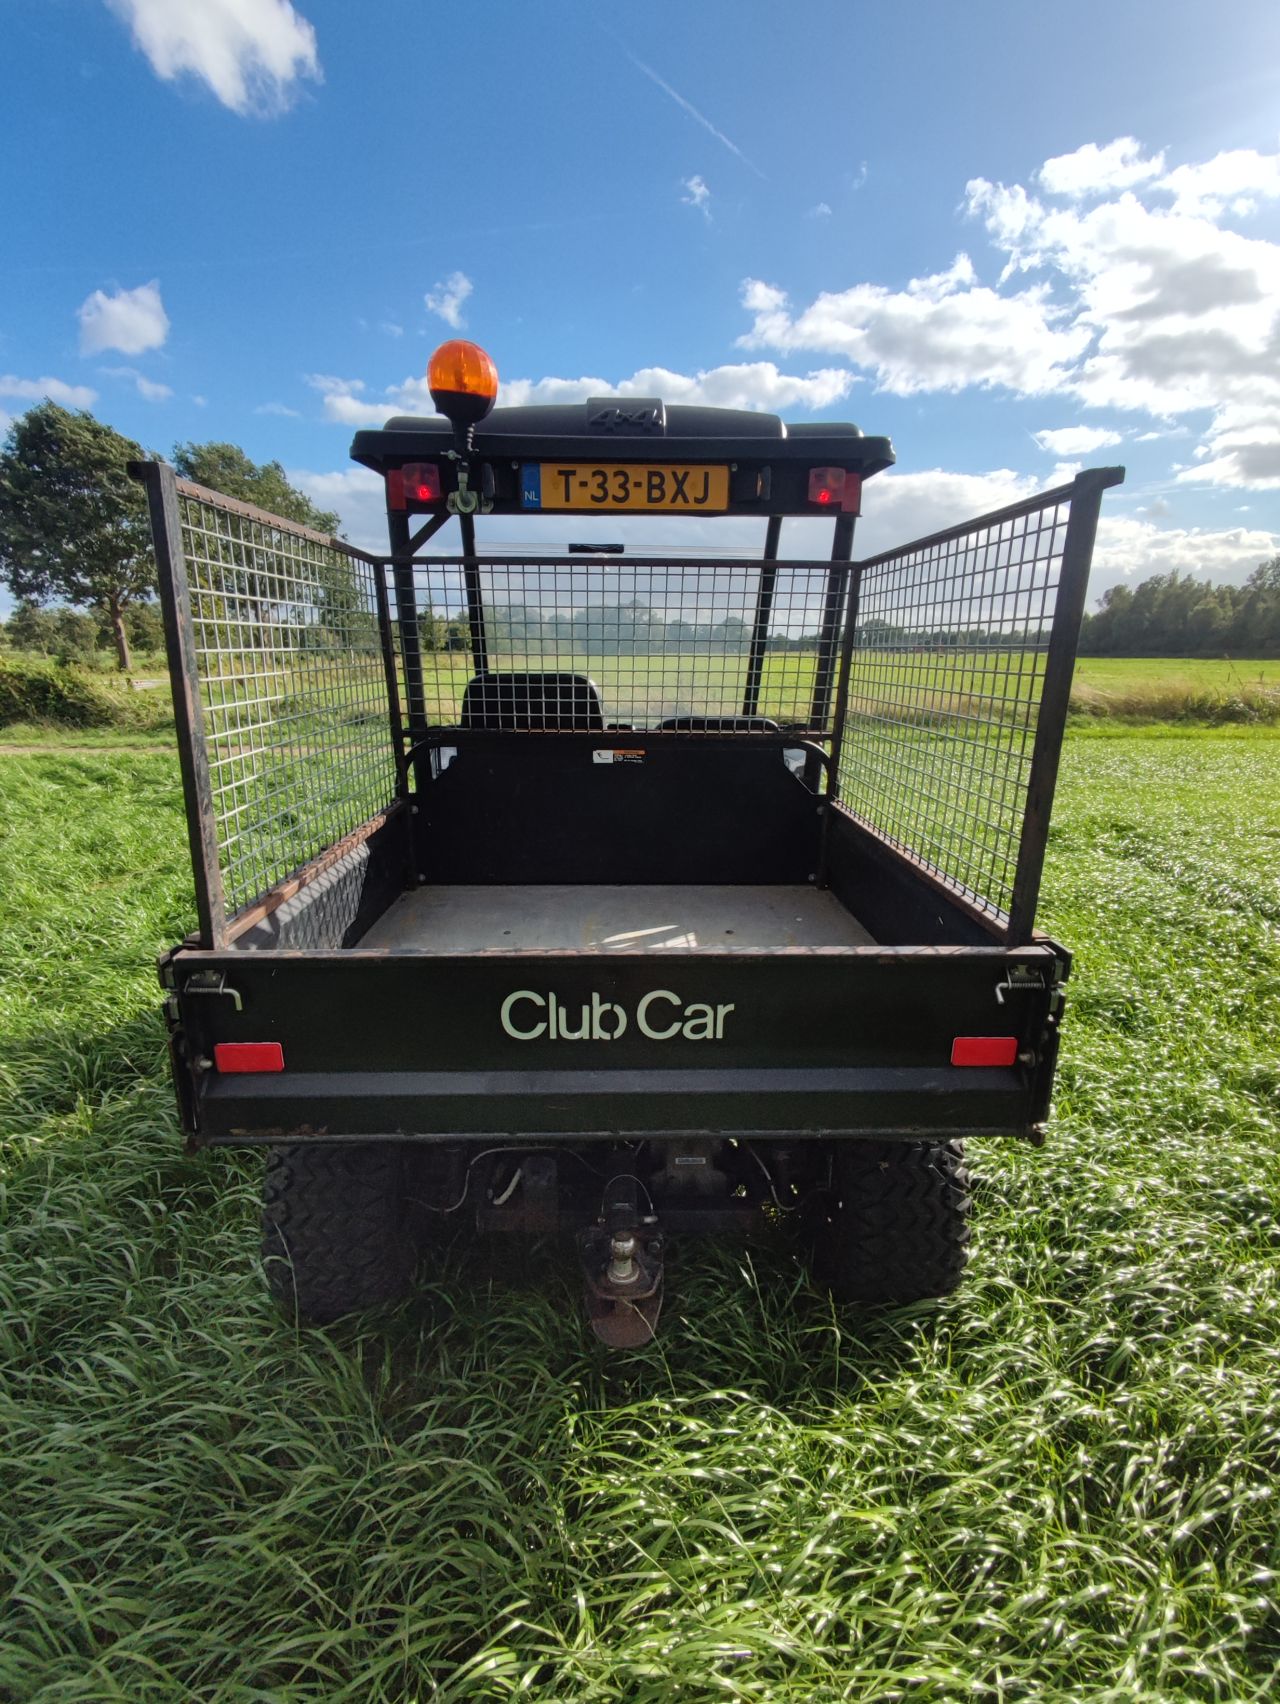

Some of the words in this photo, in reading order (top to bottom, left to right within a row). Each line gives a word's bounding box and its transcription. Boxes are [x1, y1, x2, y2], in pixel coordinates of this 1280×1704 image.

[524, 490, 539, 501] NL
[557, 469, 710, 504] T-33-BXJ
[500, 990, 628, 1040] Club
[636, 989, 735, 1040] Car
